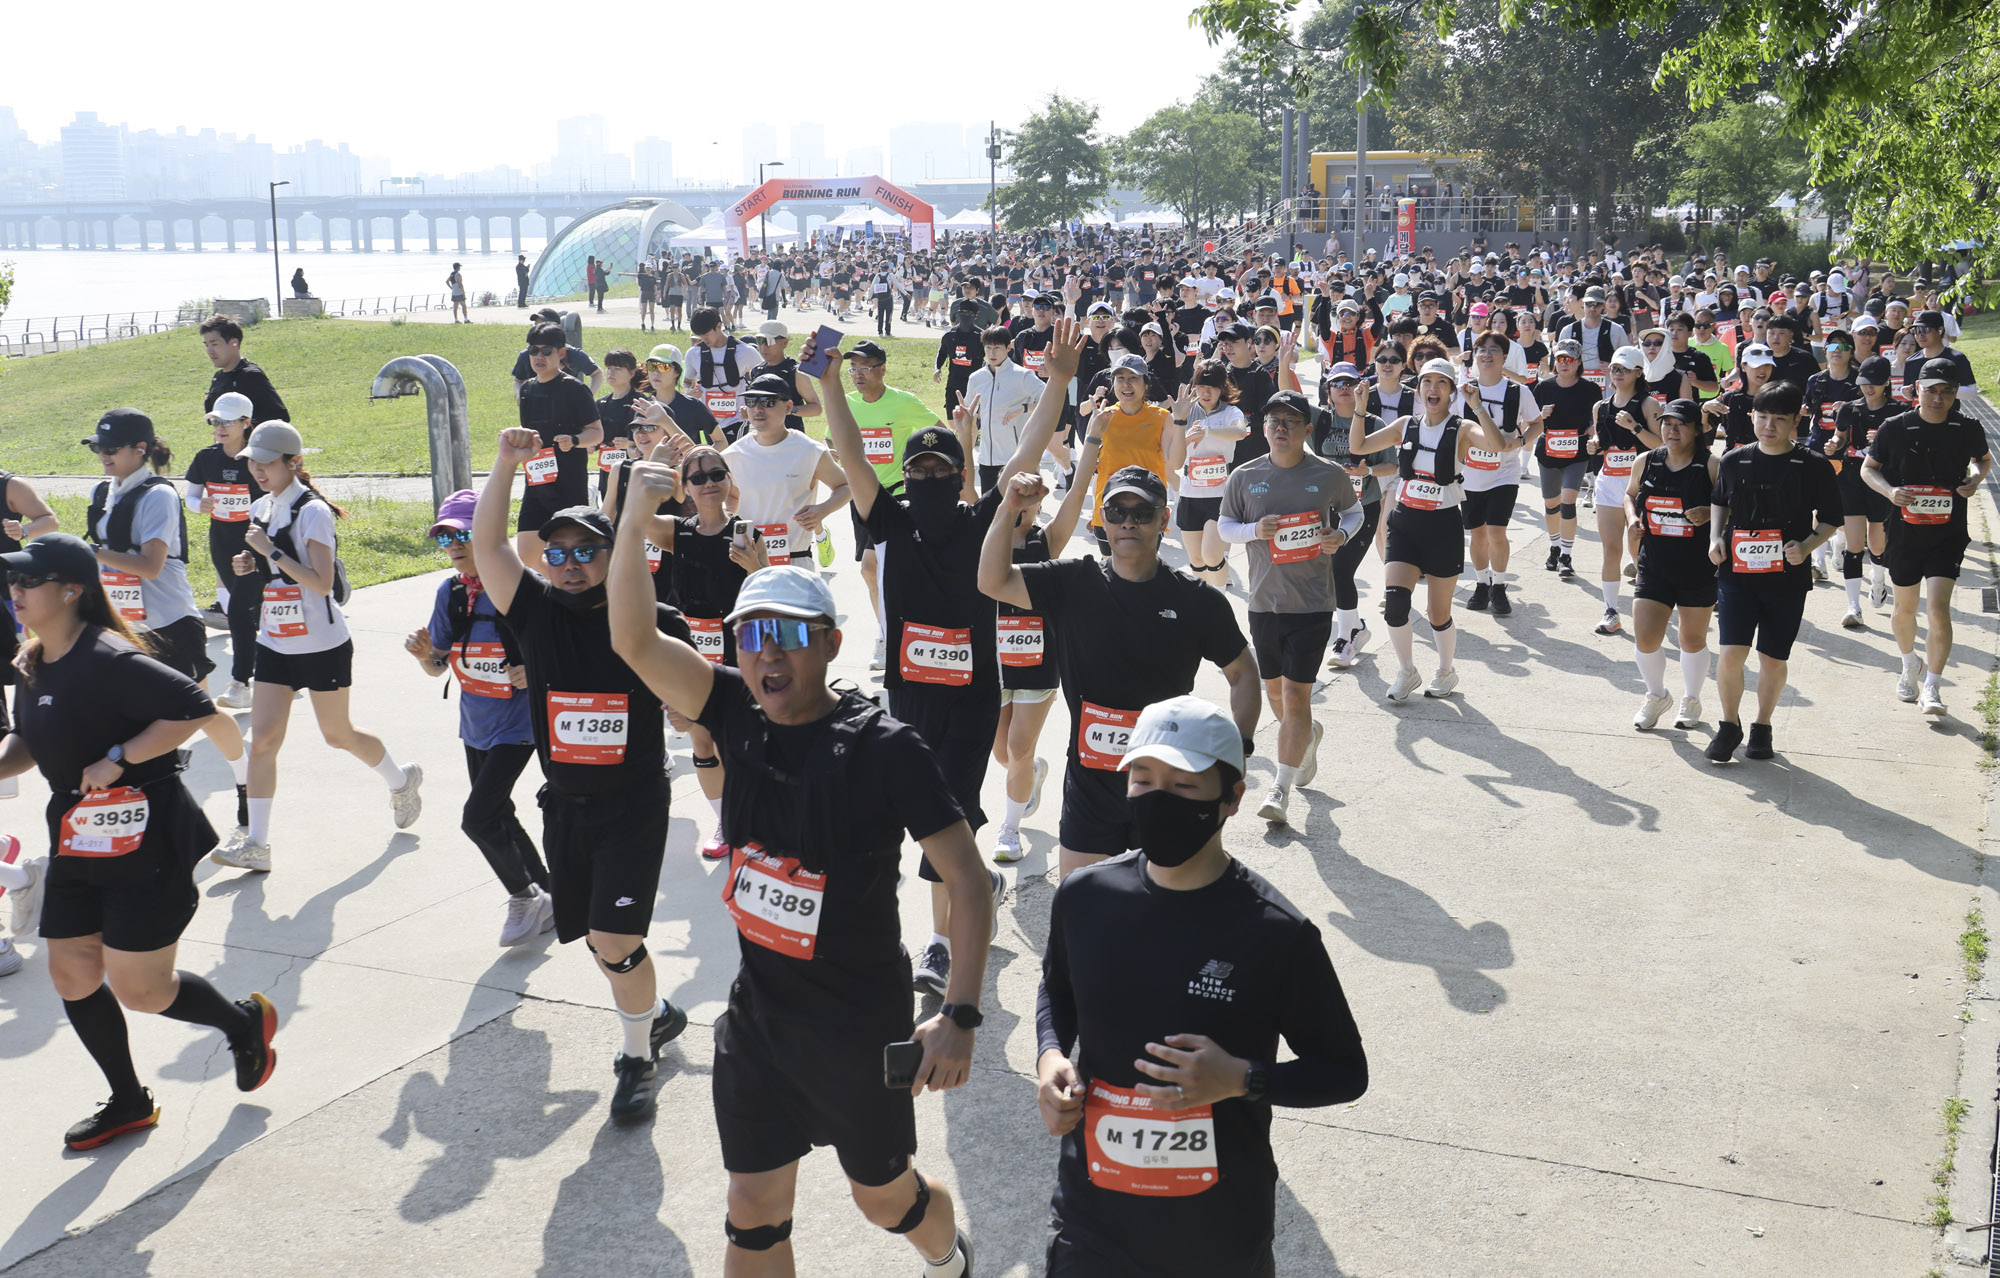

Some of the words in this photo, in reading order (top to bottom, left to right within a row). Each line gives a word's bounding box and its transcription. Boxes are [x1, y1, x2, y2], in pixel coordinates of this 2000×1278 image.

[782, 189, 833, 198] BURNING
[836, 187, 861, 198] RUN
[735, 190, 767, 216] START
[875, 186, 914, 212] FINISH
[534, 460, 555, 470] 2695
[1417, 485, 1442, 495] 4301
[1921, 499, 1950, 508] 2213
[1291, 526, 1321, 541] 2237
[1749, 545, 1779, 554] 2071
[110, 590, 140, 600] 4072
[270, 605, 298, 615] 4071
[1007, 635, 1042, 645] 4604
[914, 648, 924, 656] M
[929, 648, 969, 662] 1390
[561, 721, 571, 731] M
[577, 718, 624, 733] 1388
[1092, 730, 1102, 742] M
[75, 816, 88, 825] W
[93, 808, 145, 826] 3935
[798, 869, 821, 880] 10km
[739, 878, 752, 893] M
[758, 884, 816, 916] 1389
[1202, 976, 1222, 986] NEW
[1189, 981, 1233, 996] BALANCE
[1093, 1087, 1130, 1105] BURNING
[1107, 1128, 1122, 1144] M
[1132, 1128, 1208, 1151] 1728
